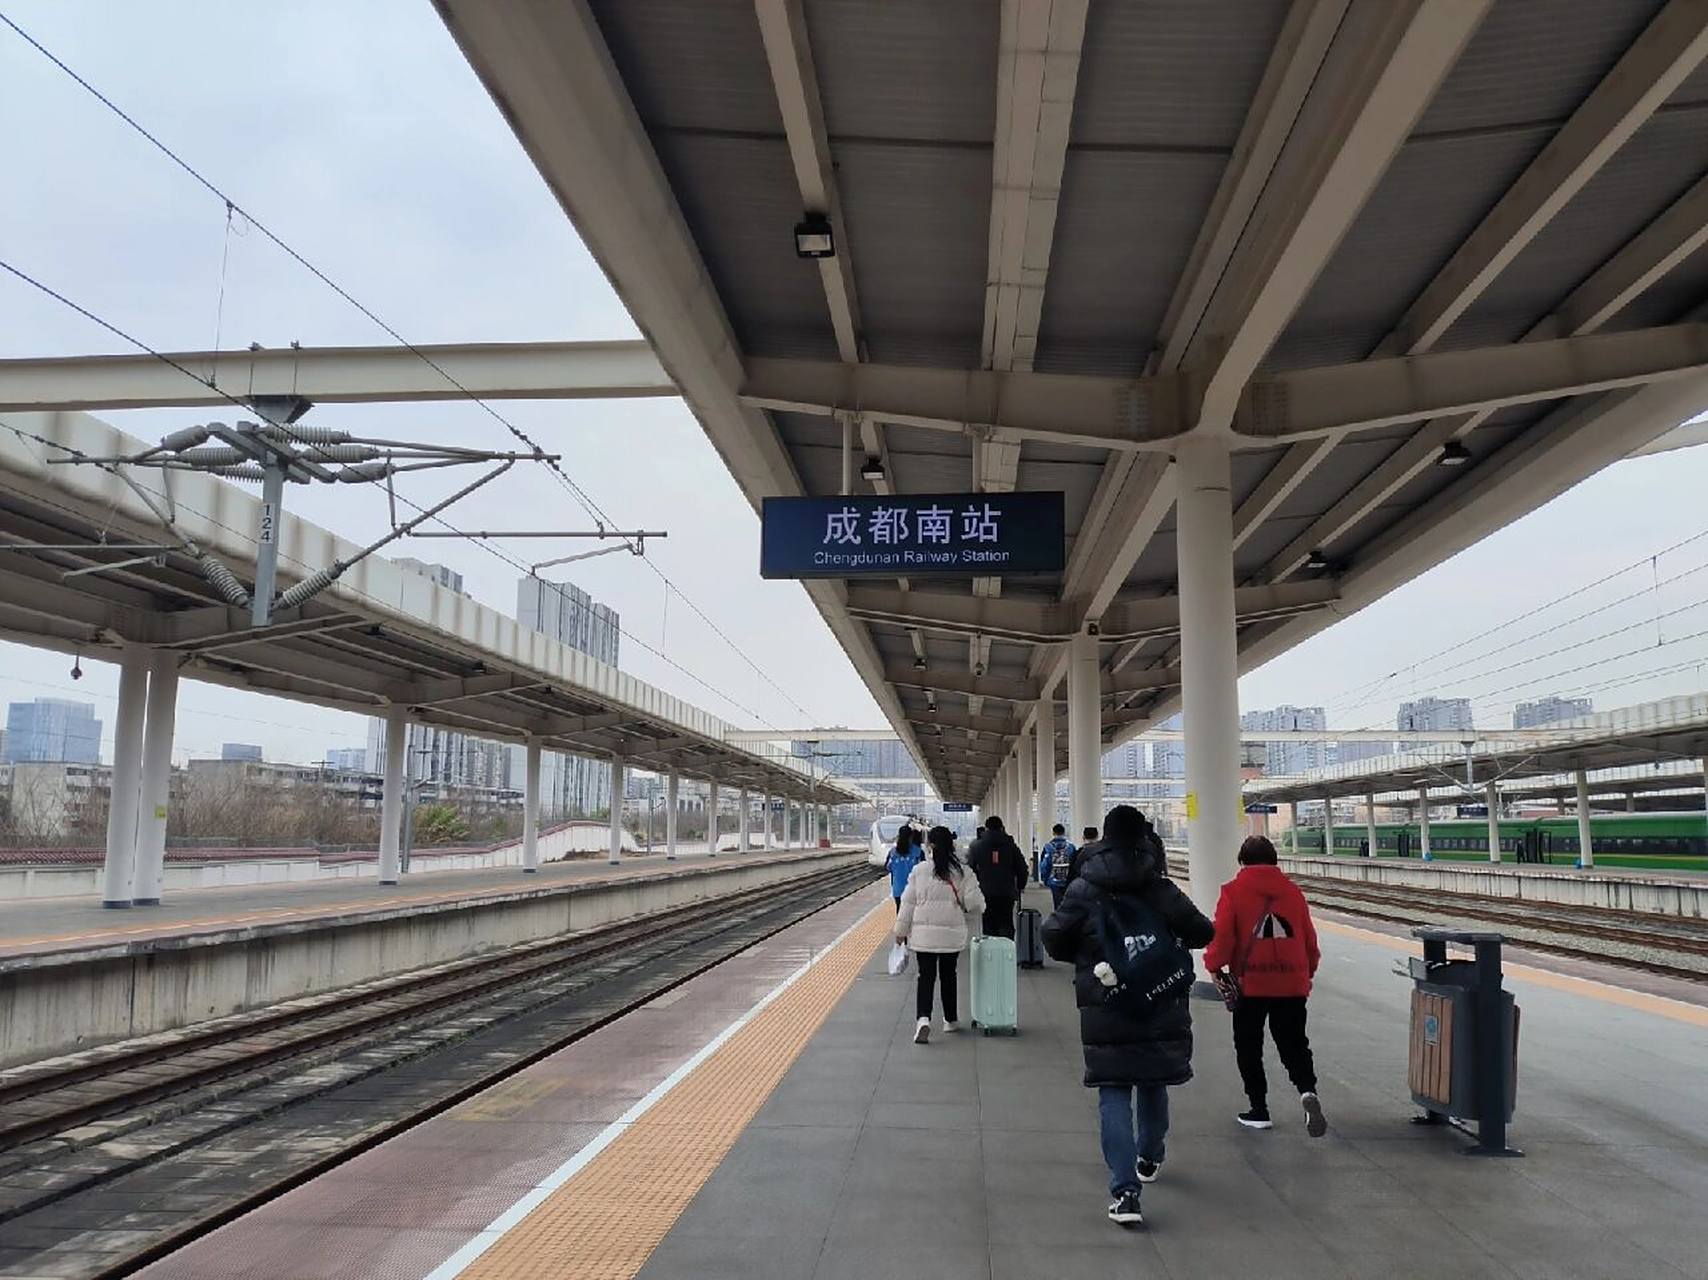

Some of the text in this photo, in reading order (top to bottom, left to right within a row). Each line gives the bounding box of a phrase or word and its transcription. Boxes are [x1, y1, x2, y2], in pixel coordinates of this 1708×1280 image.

[261, 504, 272, 542] 124
[822, 503, 1002, 545] 成都南站
[814, 549, 1010, 566] Chengdunan Railway Station
